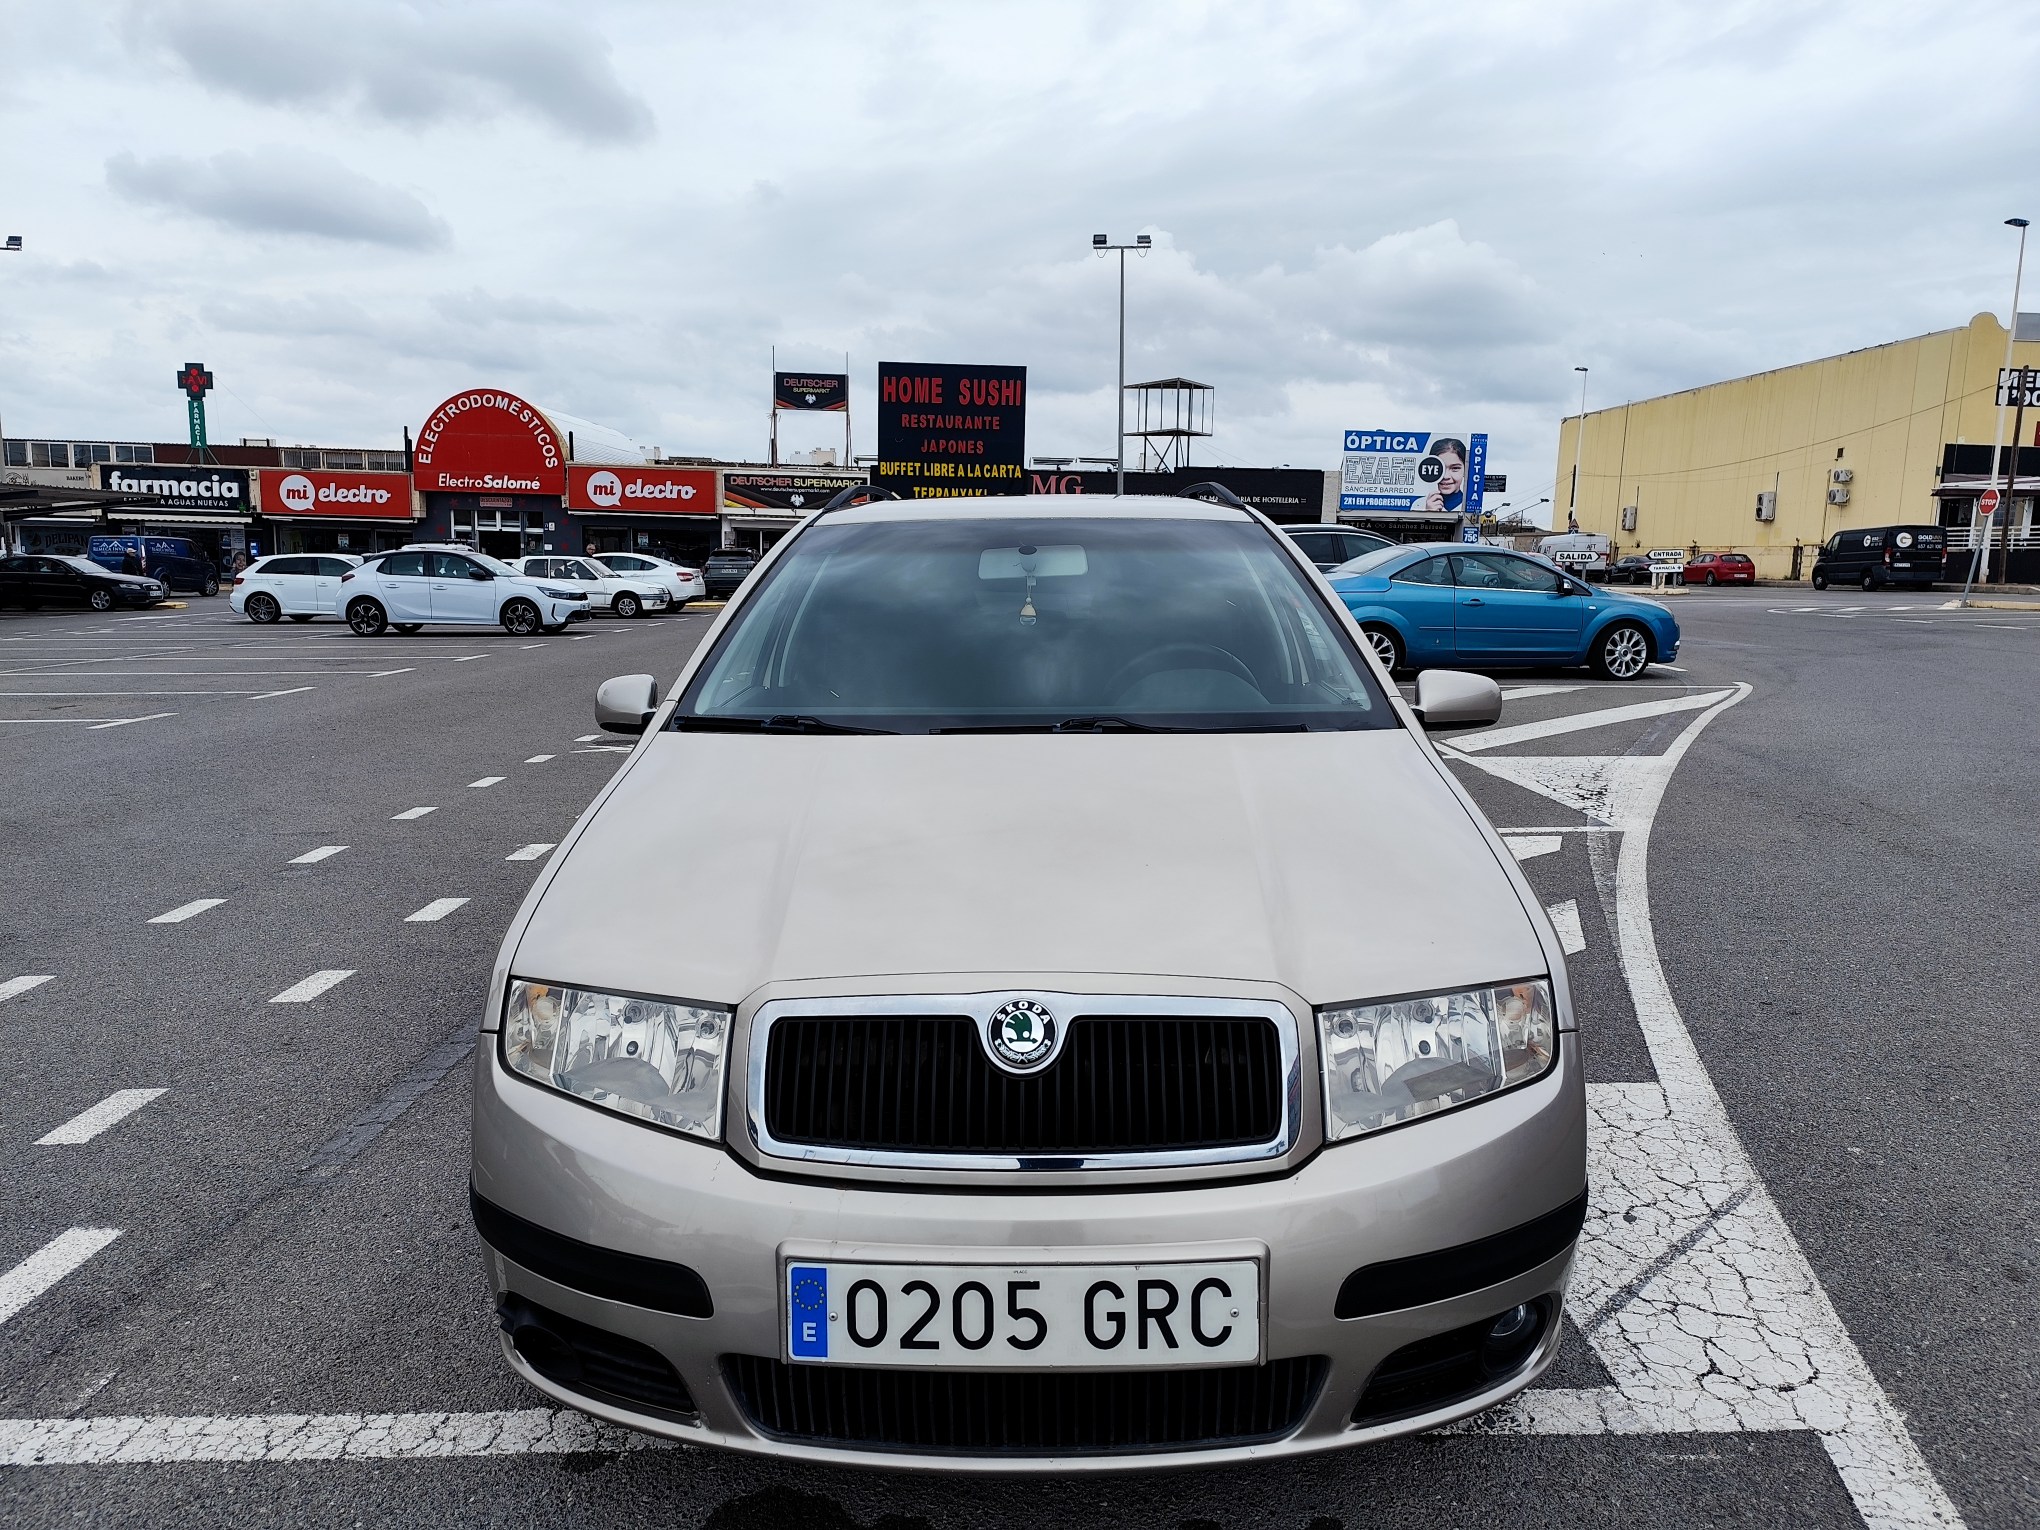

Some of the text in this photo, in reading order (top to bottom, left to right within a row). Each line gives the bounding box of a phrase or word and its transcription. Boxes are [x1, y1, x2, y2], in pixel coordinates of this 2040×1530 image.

[783, 378, 839, 388] DEUTSCHER
[883, 376, 1022, 406] HOME SUSHI
[193, 402, 202, 447] FARMACIA
[901, 413, 1000, 430] RESTAURANTE
[418, 394, 559, 468] ELECTRODOMÉSTICOS
[921, 439, 984, 454] JAPONES
[1346, 432, 1419, 451] ÓPTICA
[880, 461, 1022, 479] BUFFET LIBRE A LA CARTA
[1421, 464, 1440, 475] EYE
[109, 471, 240, 498] farmacia
[438, 473, 541, 490] ElectroSalomé
[593, 478, 697, 500] mi electro
[730, 476, 863, 488] DEUTSCHER SUPERMARKT
[760, 486, 830, 494] www.deutschersupermarkt.com
[1031, 474, 1085, 494] MG
[1344, 485, 1378, 493] SÁNCHEZ
[286, 483, 391, 504] mi electro
[1344, 497, 1356, 505] 2X1
[1365, 498, 1411, 507] PROGRESIVOS
[1981, 498, 1996, 506] STOP
[168, 498, 195, 506] AGUAS
[197, 499, 229, 507] NUEVAS
[1559, 552, 1593, 561] SALIDA
[845, 1278, 1048, 1350] 0205
[1083, 1277, 1233, 1350] GRC
[802, 1322, 817, 1342] E
